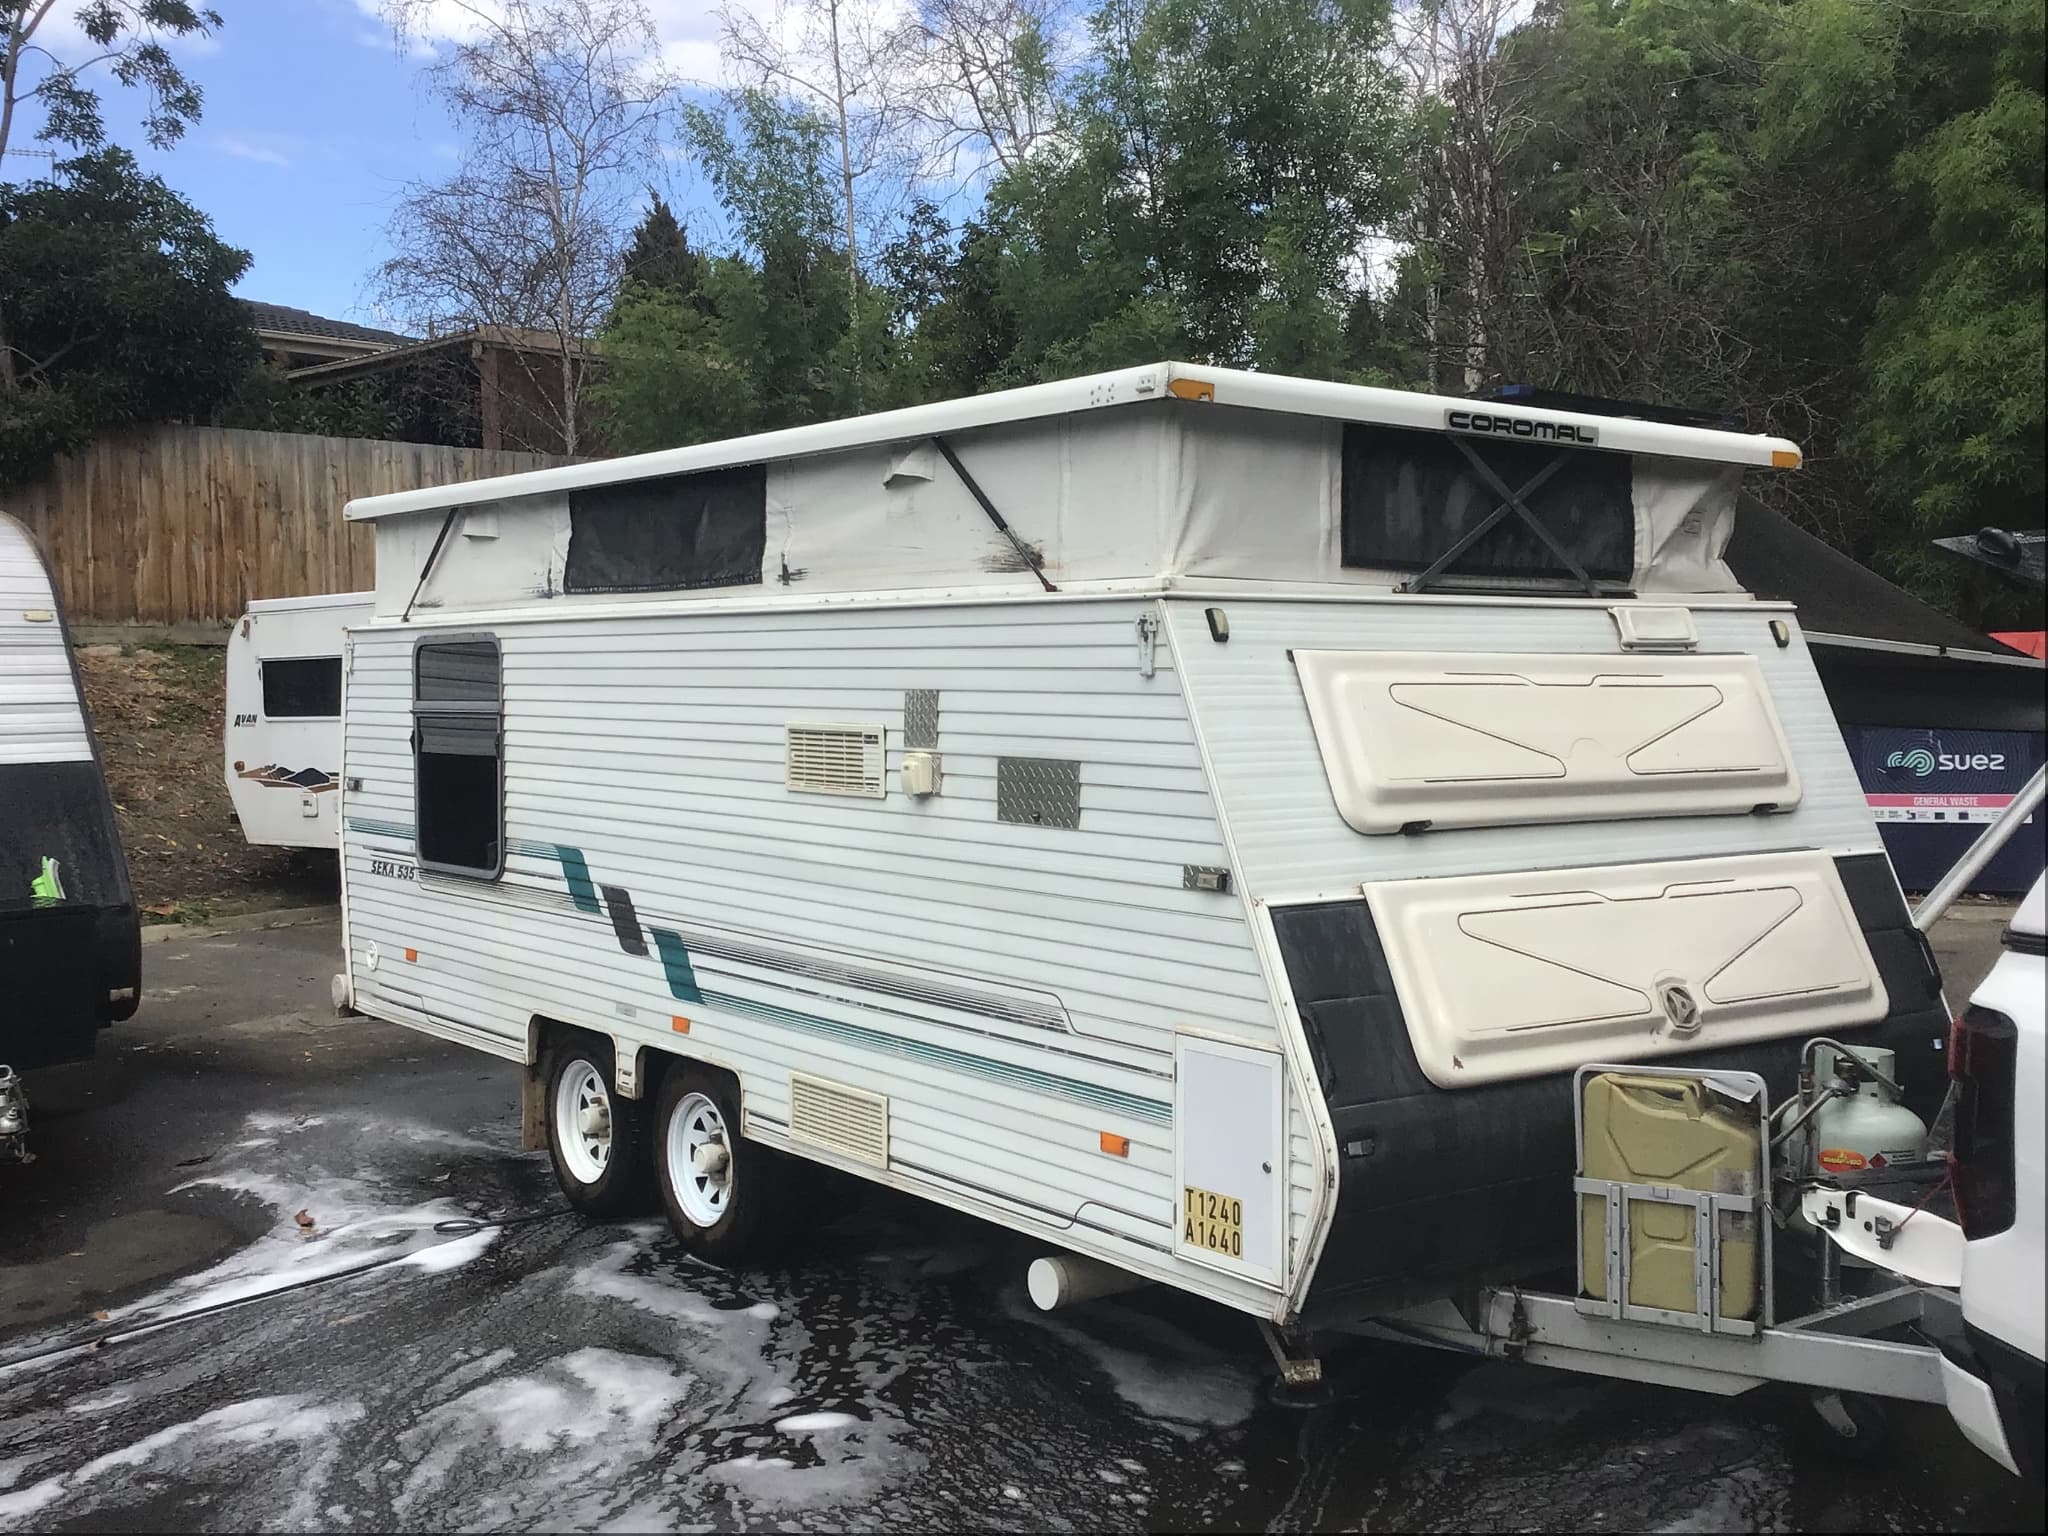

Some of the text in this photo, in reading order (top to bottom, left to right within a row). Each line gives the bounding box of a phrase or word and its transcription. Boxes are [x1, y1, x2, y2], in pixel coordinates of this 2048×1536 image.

[1449, 411, 1594, 443] COROMAL
[1913, 796, 1979, 806] GENERAL WASTE
[371, 861, 415, 880] SEKA 535
[1185, 1188, 1241, 1226] T1240
[1185, 1217, 1241, 1256] A1640
